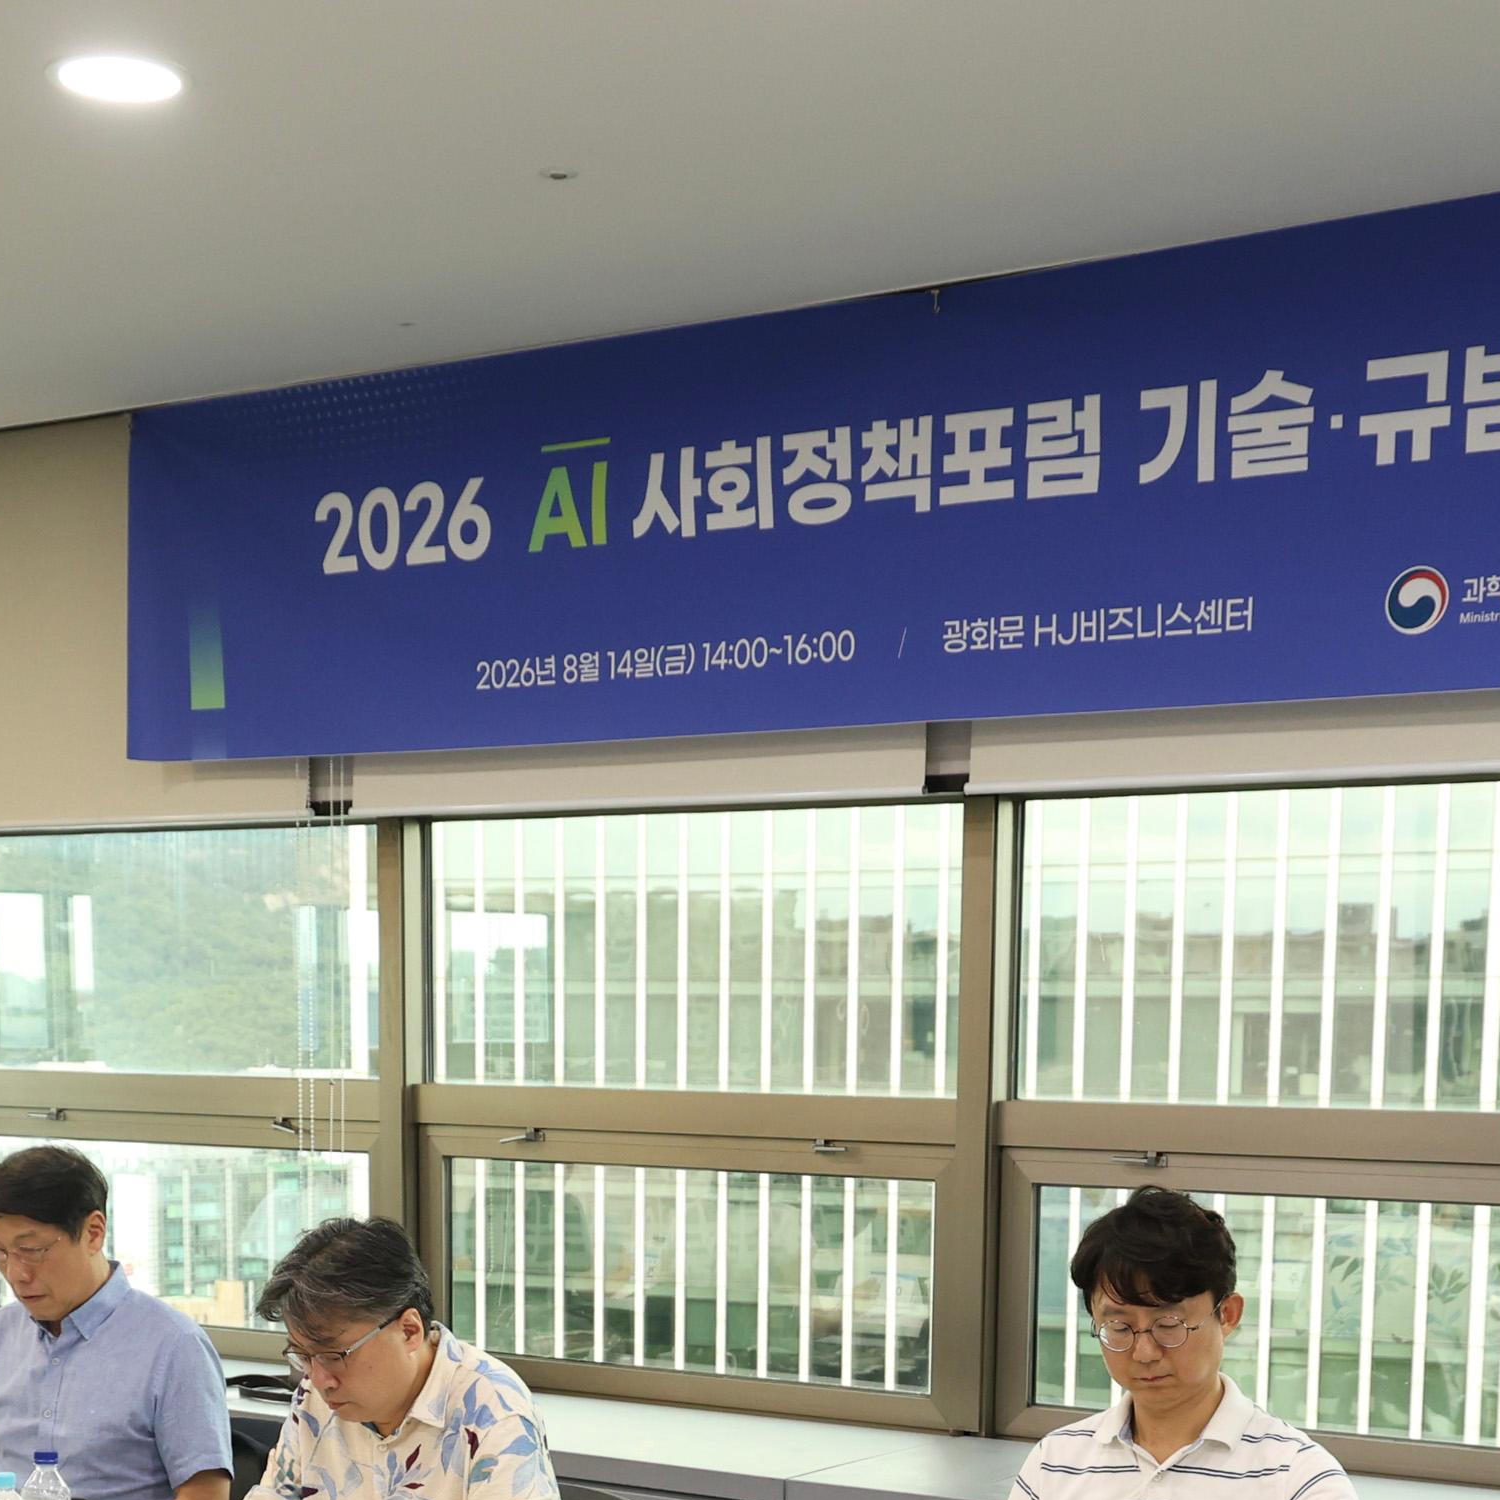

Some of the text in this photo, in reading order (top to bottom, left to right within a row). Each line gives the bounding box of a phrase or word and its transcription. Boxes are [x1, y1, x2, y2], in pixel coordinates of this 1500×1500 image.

[314, 477, 491, 575] 2026
[528, 458, 610, 553] AI
[632, 394, 1101, 539] 사회정책포럼
[942, 595, 1254, 654] 광화문 HJ비즈니스센터
[475, 629, 856, 690] 2026년 8월 14일(금) 14:00~16:00
